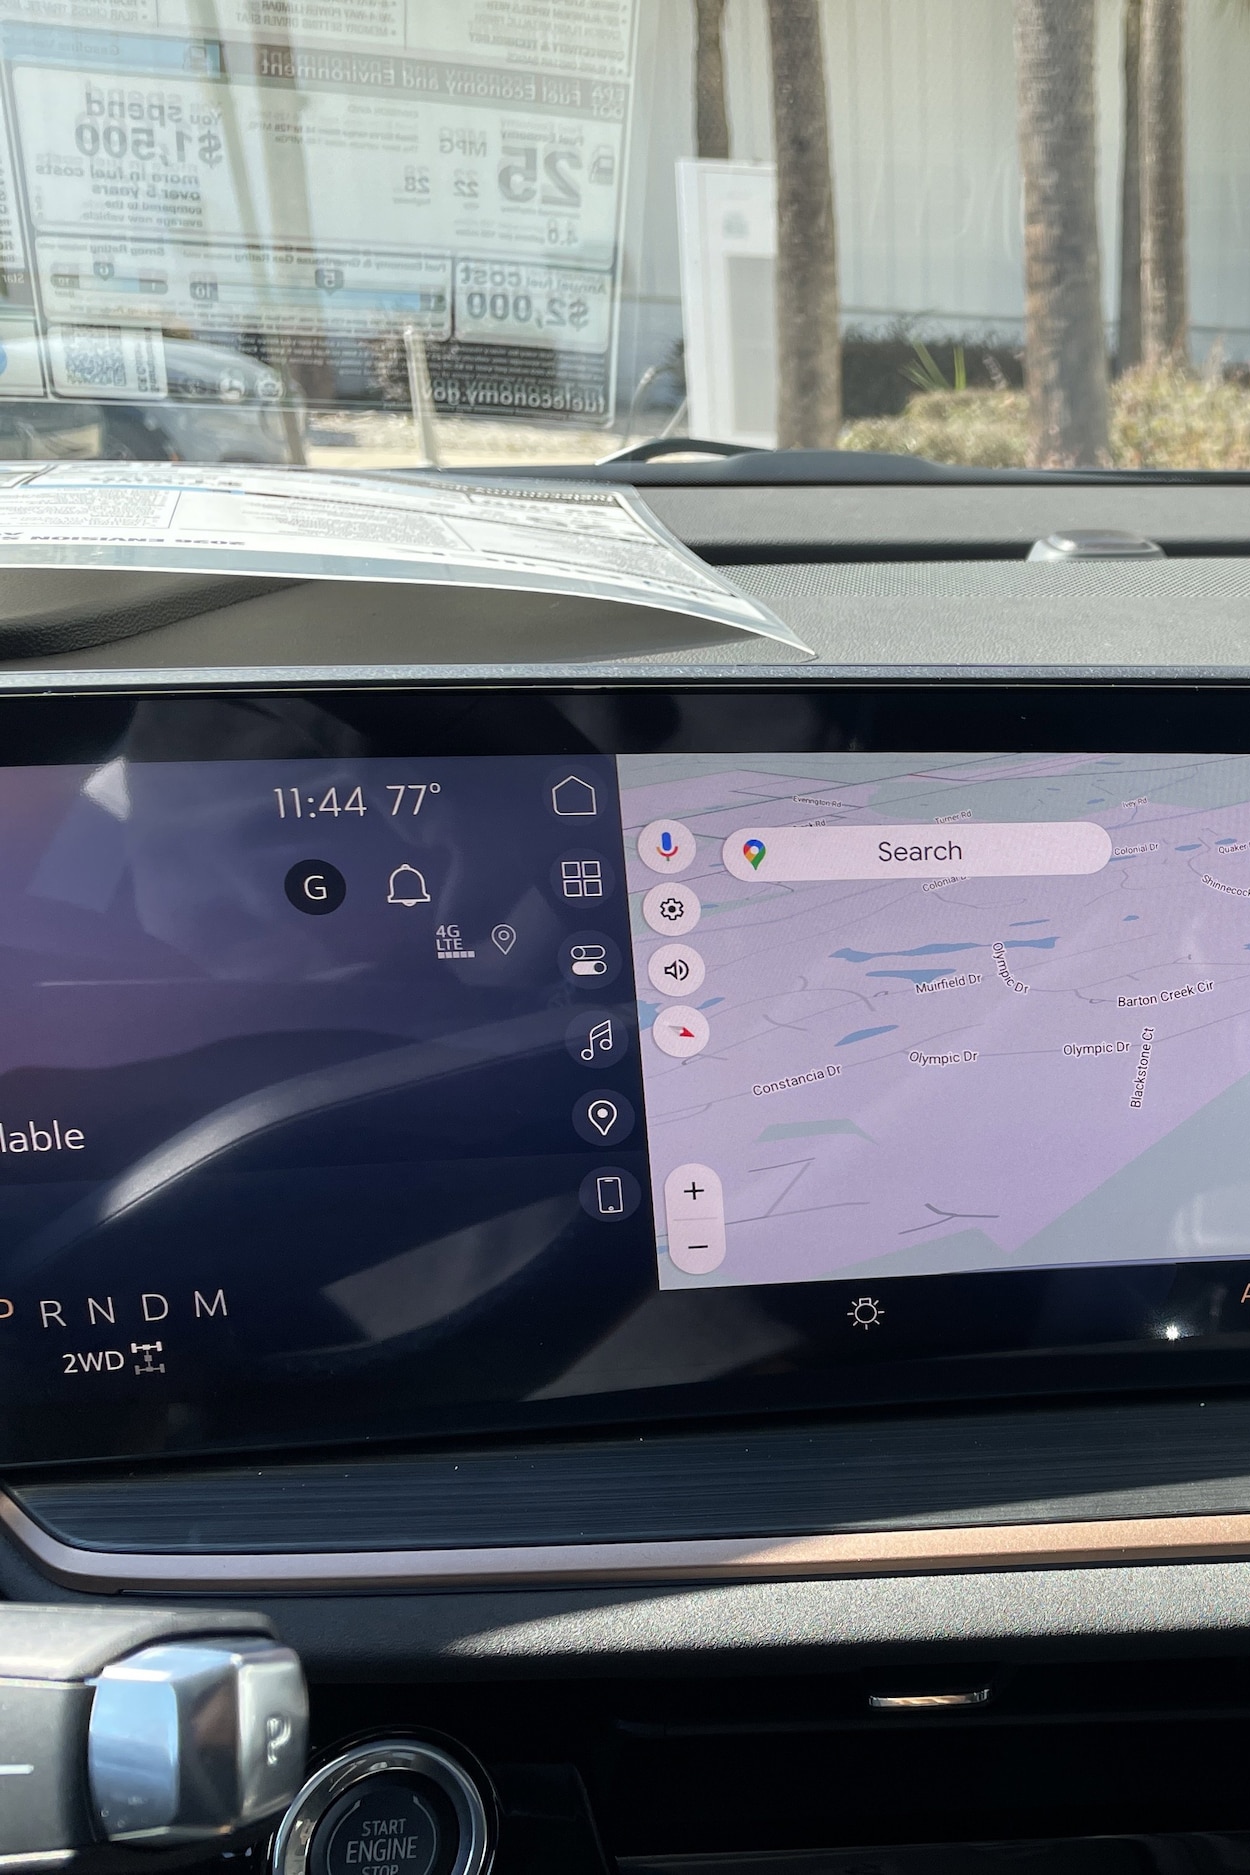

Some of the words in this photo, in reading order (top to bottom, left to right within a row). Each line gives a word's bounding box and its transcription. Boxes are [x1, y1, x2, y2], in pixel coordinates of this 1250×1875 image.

[273, 785, 367, 819] 11:44
[386, 782, 441, 816] 77°
[832, 800, 842, 808] Rd
[1138, 798, 1147, 806] Rd
[961, 810, 972, 820] Rd
[878, 840, 963, 862] Search
[1114, 844, 1148, 856] Colonial
[1150, 842, 1159, 851] Dr
[1218, 842, 1248, 855] Quaker
[303, 874, 327, 901] G
[435, 923, 460, 938] 4G
[435, 938, 463, 951] LTE
[992, 942, 1014, 988] Olympic
[1014, 981, 1030, 994] Dr
[915, 976, 965, 995] Muirfield
[968, 973, 982, 985] Dr
[1117, 993, 1157, 1008] Barton
[1160, 985, 1195, 1003] Creek
[1196, 980, 1214, 993] Cir
[908, 1050, 961, 1067] Olympic
[963, 1050, 978, 1063] Dr
[1063, 1042, 1114, 1058] Olympic
[1116, 1041, 1130, 1052] Dr
[1130, 1043, 1152, 1109] Blackstone
[1141, 1027, 1155, 1042] Ct
[752, 1068, 825, 1097] Constancia
[826, 1064, 842, 1077] Dr
[39, 1299, 67, 1328] R
[87, 1296, 116, 1325] N
[141, 1293, 169, 1321] D
[194, 1288, 228, 1318] M
[62, 1350, 125, 1374] 2WD
[361, 1818, 407, 1837] START
[345, 1836, 418, 1864] ENGINE
[361, 1864, 399, 1875] STOP
